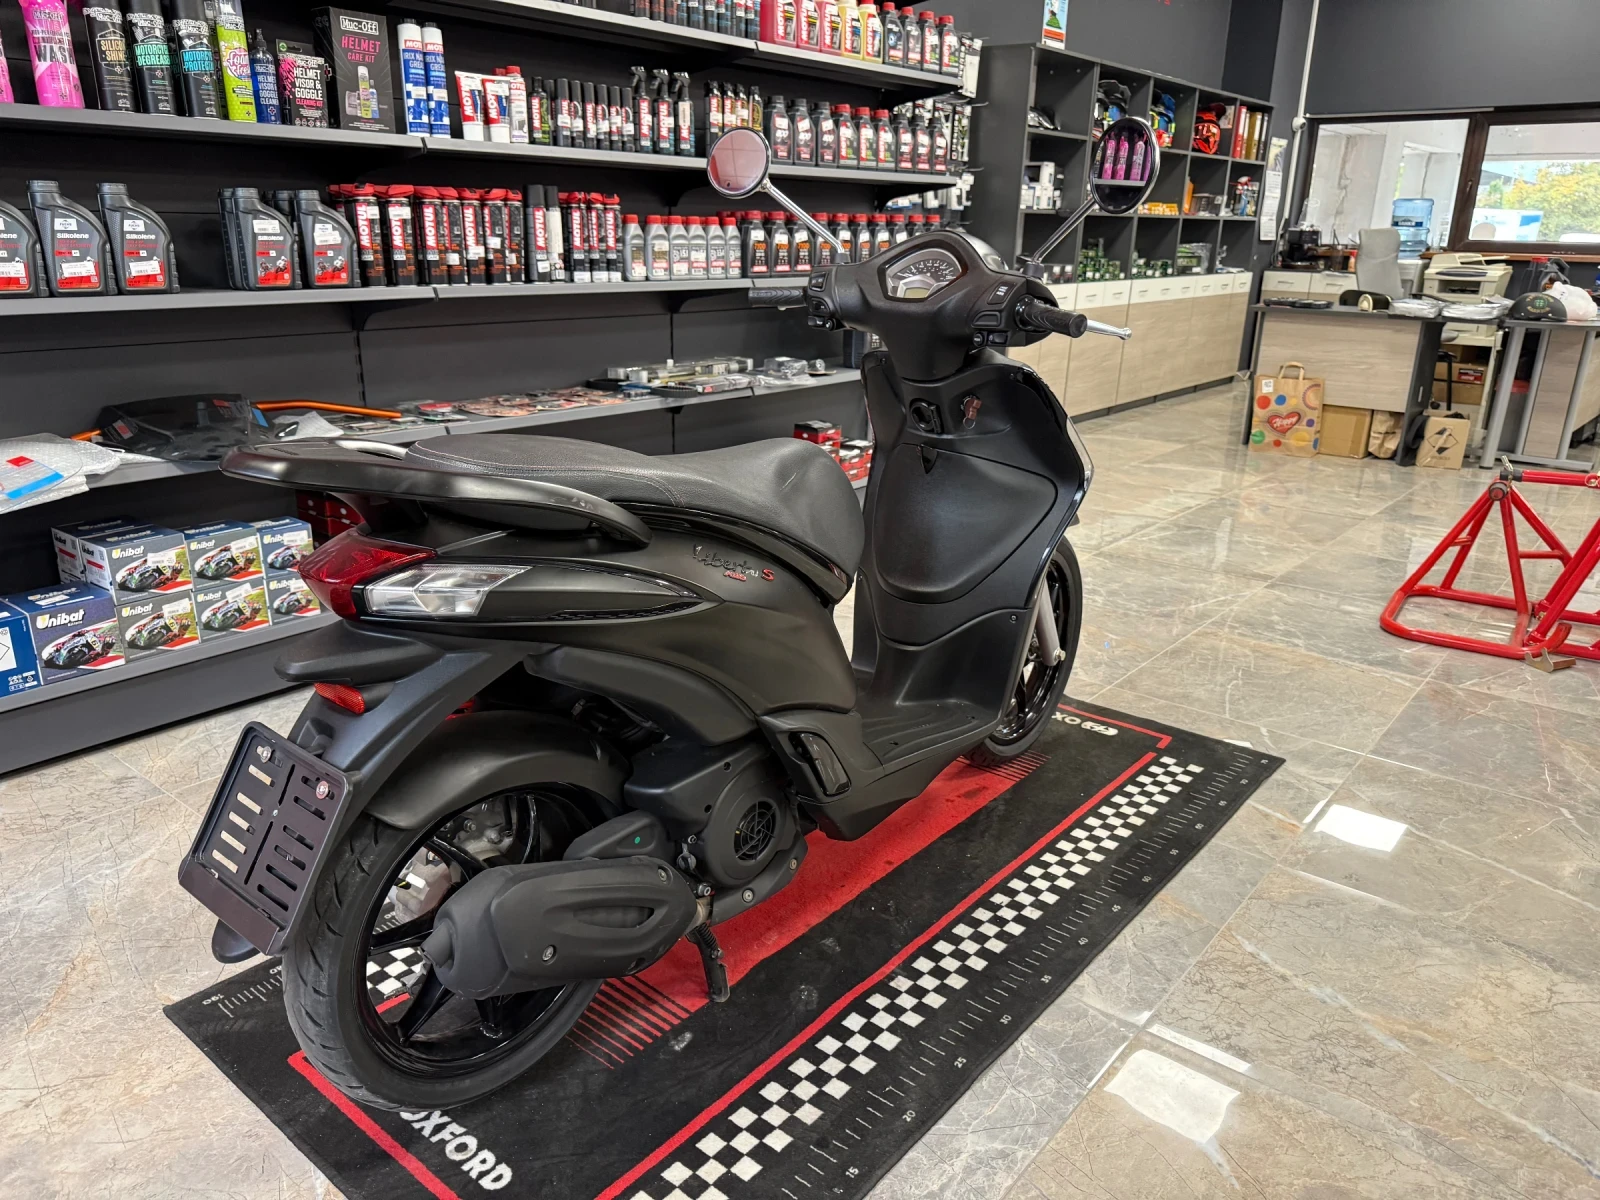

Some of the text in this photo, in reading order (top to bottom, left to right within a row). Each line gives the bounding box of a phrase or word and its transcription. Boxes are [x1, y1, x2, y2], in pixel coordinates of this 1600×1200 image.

[342, 18, 378, 33] Muc-Off
[341, 35, 381, 53] HELMET
[33, 44, 75, 65] WASH
[347, 52, 375, 63] CARE KIT
[294, 66, 322, 80] HELMET
[295, 77, 322, 90] VISOR &
[296, 87, 324, 101] GOGGLE
[532, 98, 541, 129] MOTUL
[357, 204, 370, 247] MOTUL
[424, 206, 437, 248] MOTUL
[533, 207, 545, 248] MOTUL
[572, 209, 582, 248] MOTUL
[606, 209, 615, 248] MOTUL
[190, 539, 216, 551] Unibat
[112, 545, 145, 560] Unibat
[761, 568, 775, 582] S
[197, 590, 223, 602] Unibat
[122, 603, 154, 619] Unibat
[36, 609, 85, 630] Unibat
[1078, 937, 1089, 946] 40
[1040, 974, 1052, 984] 35
[999, 1014, 1012, 1025] 30
[954, 1056, 967, 1069] 25
[902, 1109, 916, 1122] 20
[845, 1166, 859, 1179] 15
